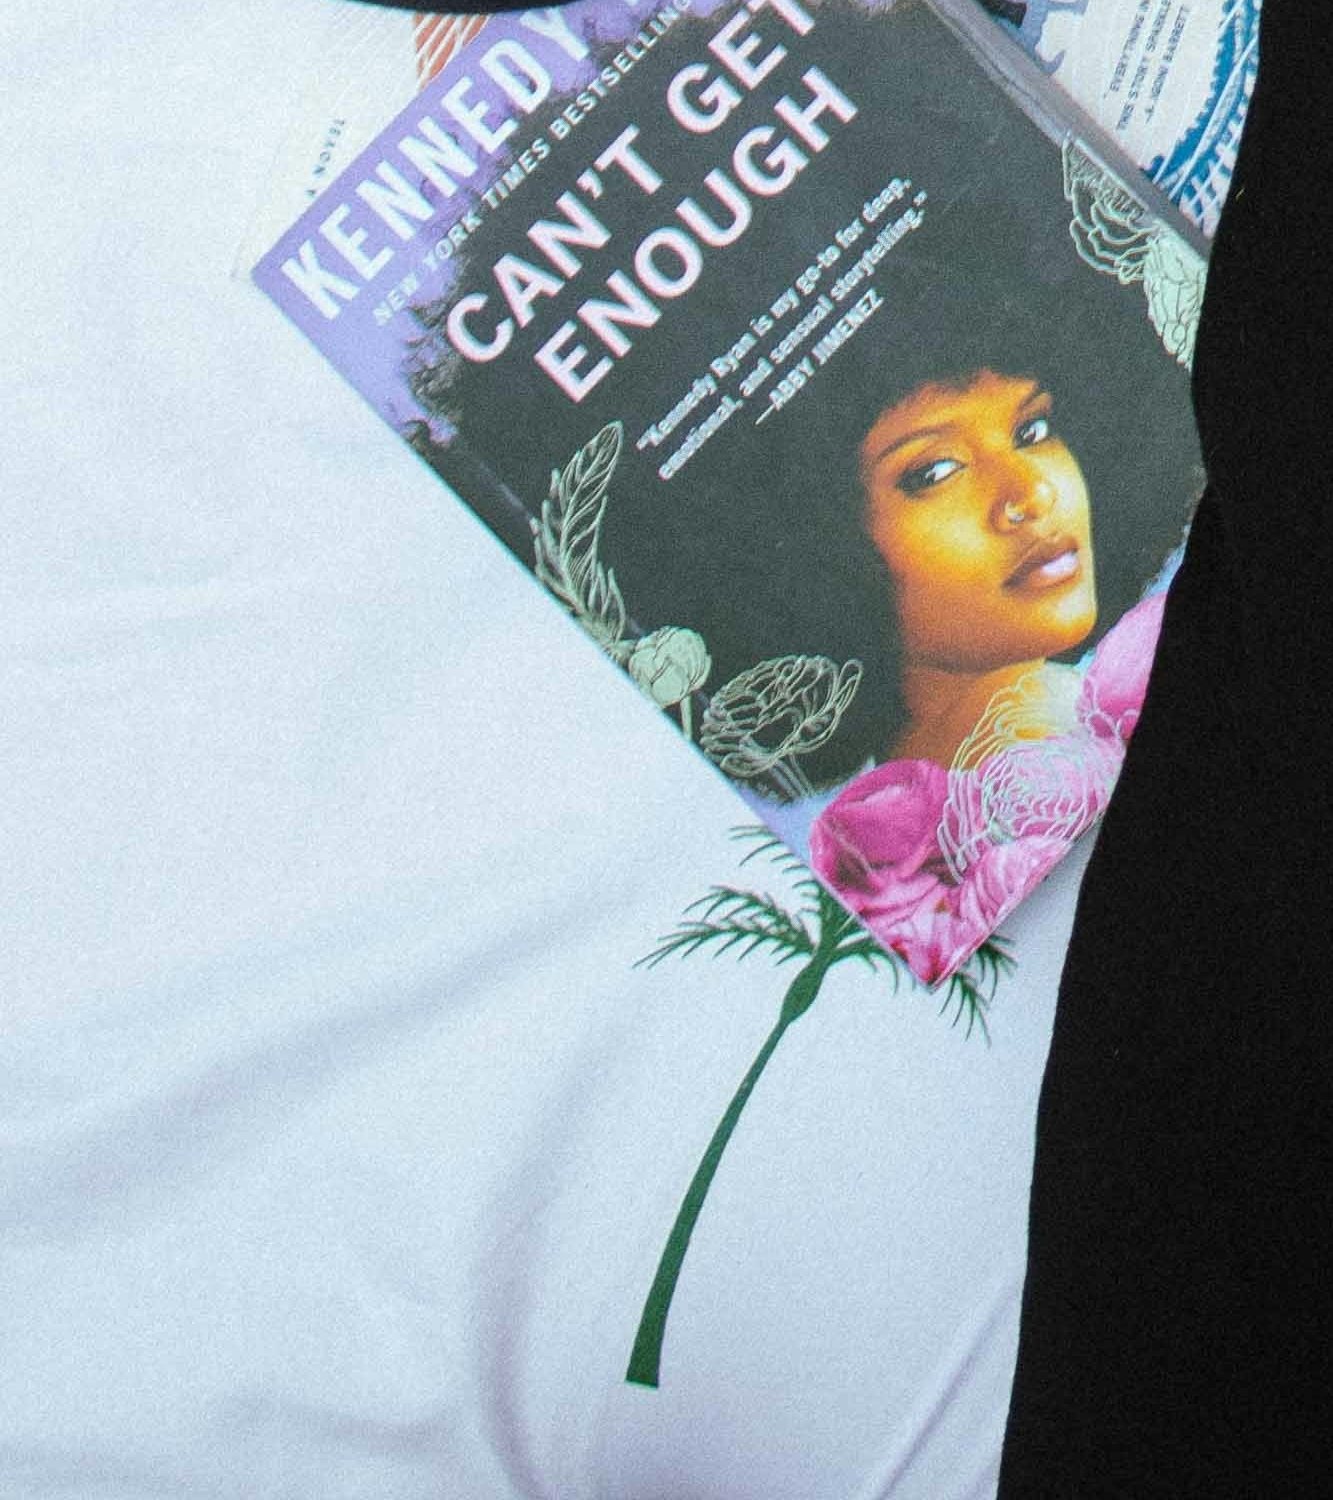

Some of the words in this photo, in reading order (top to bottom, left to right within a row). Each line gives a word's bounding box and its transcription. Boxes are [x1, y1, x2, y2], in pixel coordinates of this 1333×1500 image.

[280, 4, 590, 322] KENNEDY
[372, 274, 421, 328] NEW
[422, 204, 484, 273] YORK
[480, 137, 552, 213] TIMES
[446, 122, 664, 364] CAN'T
[533, 65, 859, 404] ENOUGH
[710, 332, 759, 379] Ryan
[750, 313, 775, 338] is
[769, 286, 801, 320] my
[795, 244, 842, 296] go-to
[834, 218, 866, 250] for
[738, 356, 775, 398] and
[769, 294, 837, 367] sensual
[811, 286, 885, 366] JIMENEZ
